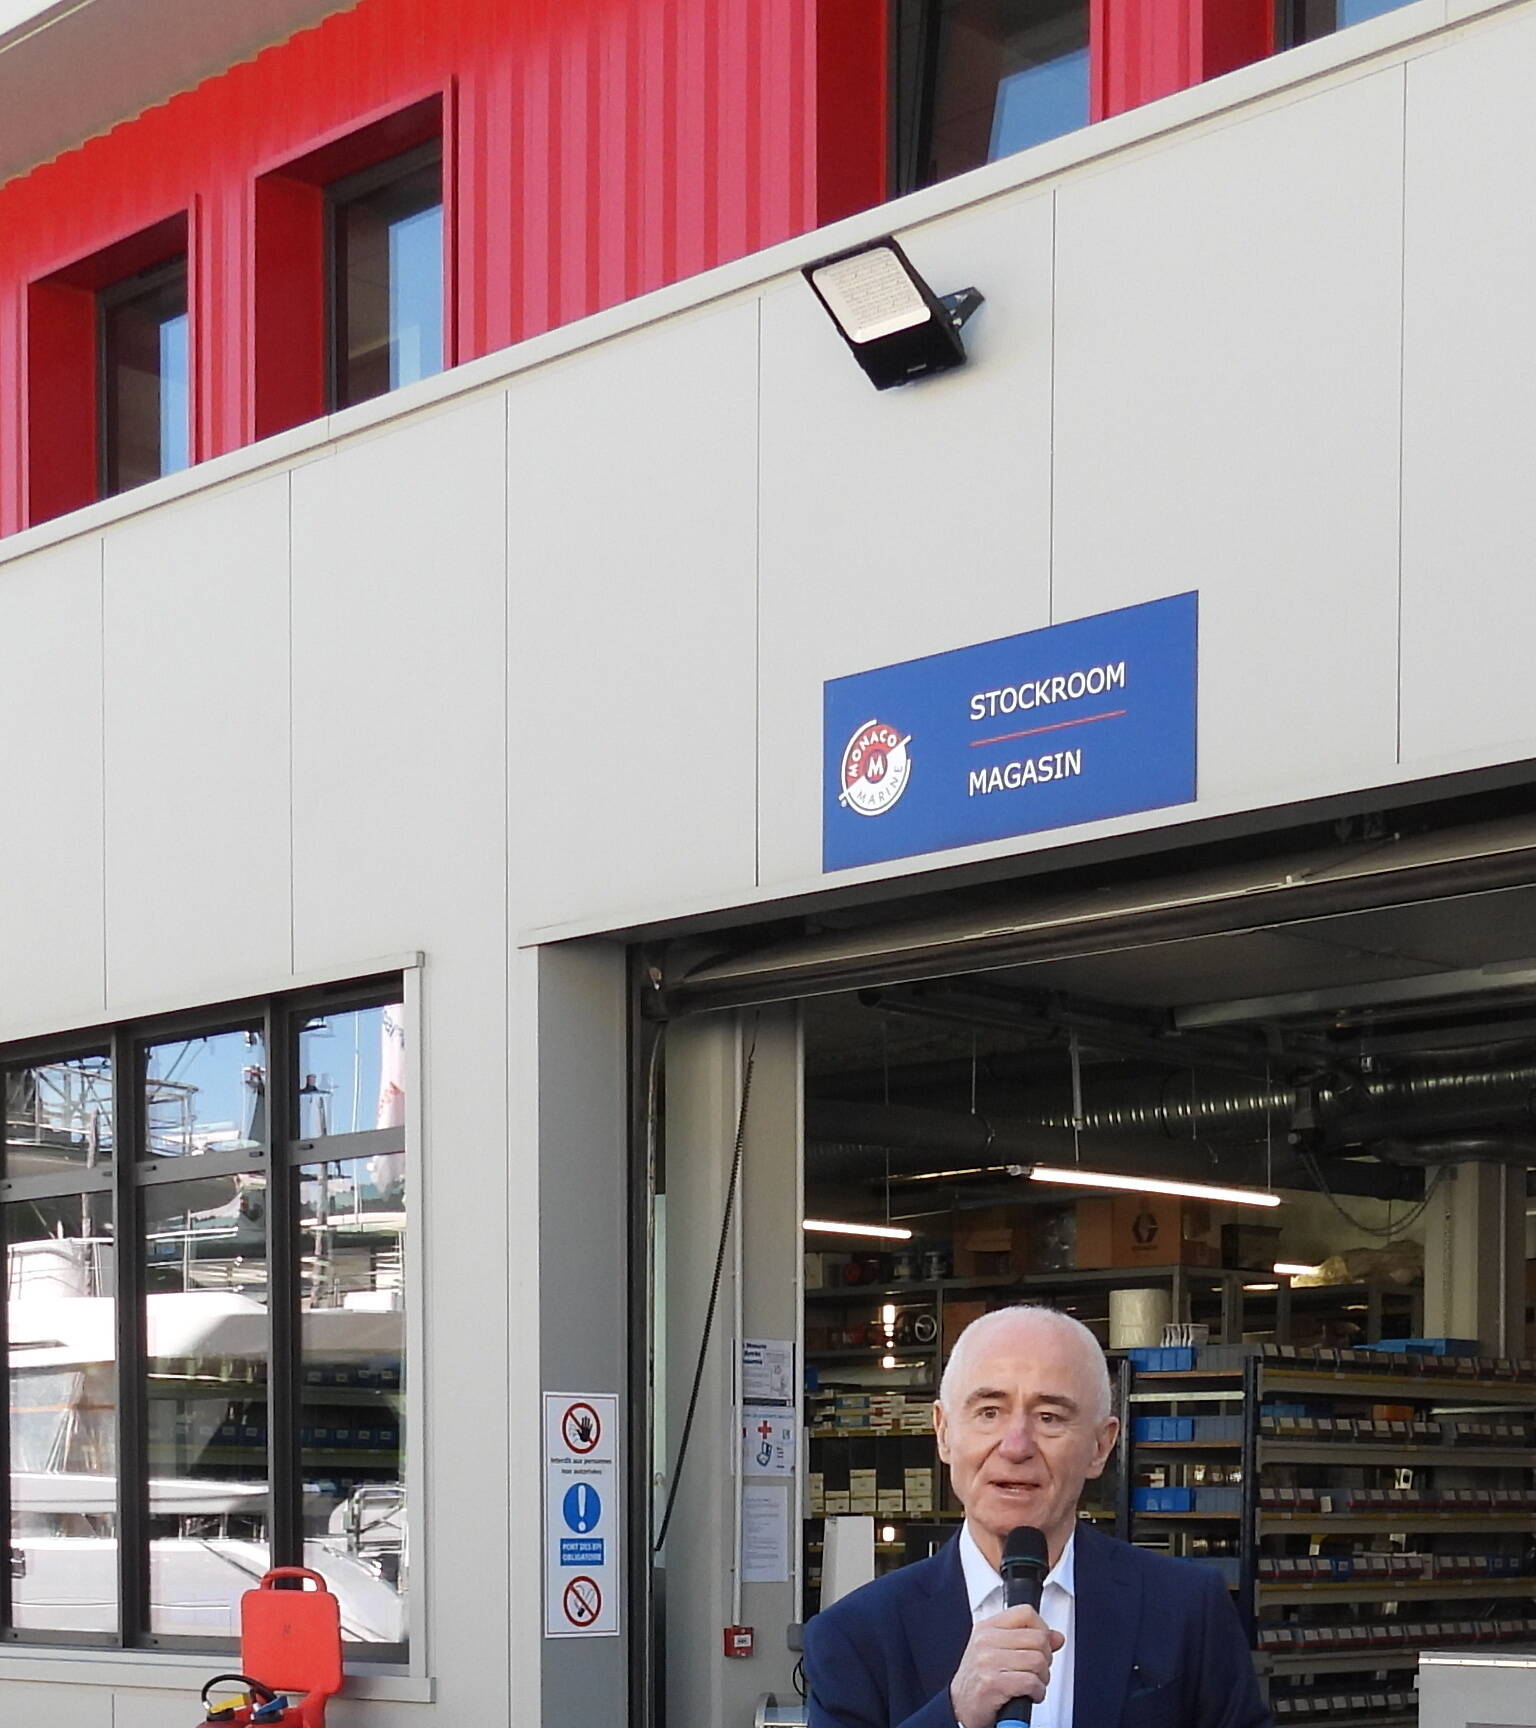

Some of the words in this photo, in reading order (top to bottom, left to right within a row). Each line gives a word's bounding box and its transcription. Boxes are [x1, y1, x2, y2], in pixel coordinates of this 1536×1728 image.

[969, 662, 1126, 720] STOCKROOM
[848, 729, 898, 777] MONACO
[867, 754, 885, 778] M
[968, 749, 1082, 797] MAGASIN
[857, 765, 904, 805] MARINE
